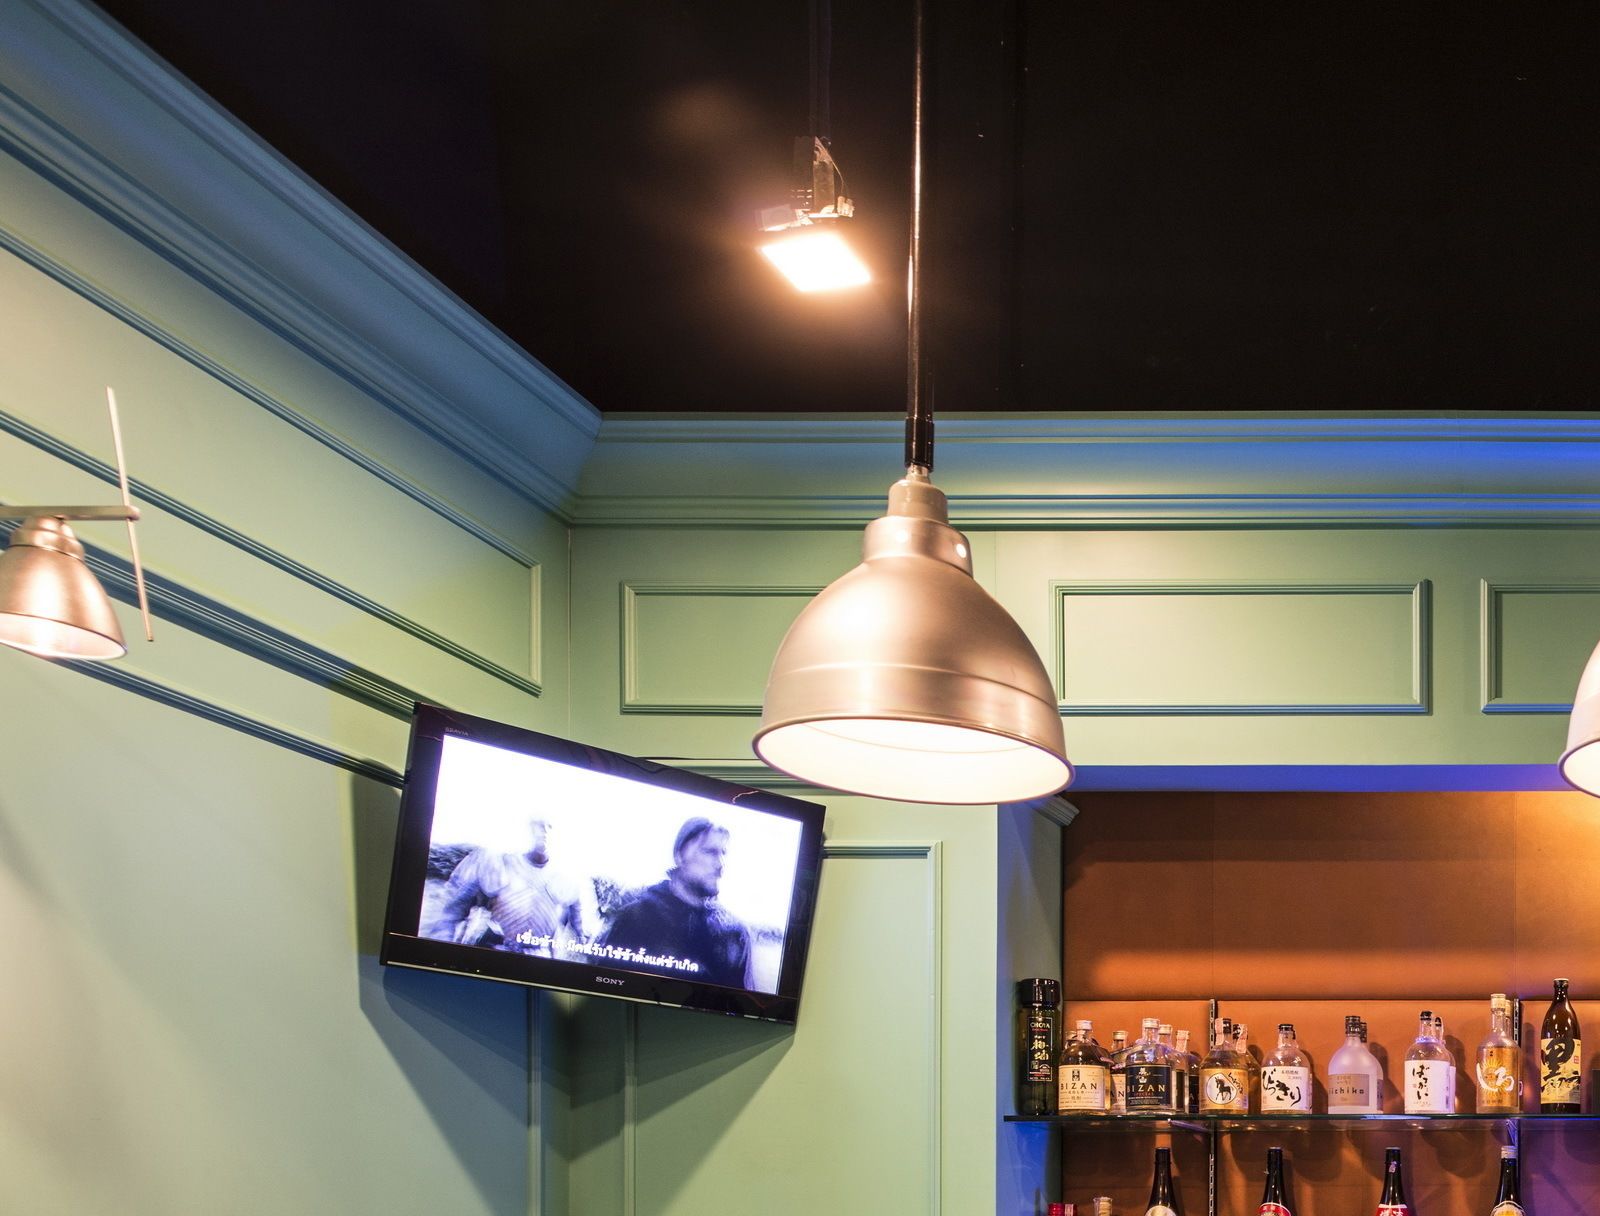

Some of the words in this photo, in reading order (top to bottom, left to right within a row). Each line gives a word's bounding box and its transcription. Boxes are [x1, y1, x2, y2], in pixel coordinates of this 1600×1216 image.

[595, 976, 626, 986] SONY
[1060, 1083, 1098, 1091] BIZAN
[1127, 1085, 1166, 1093] BIZAN
